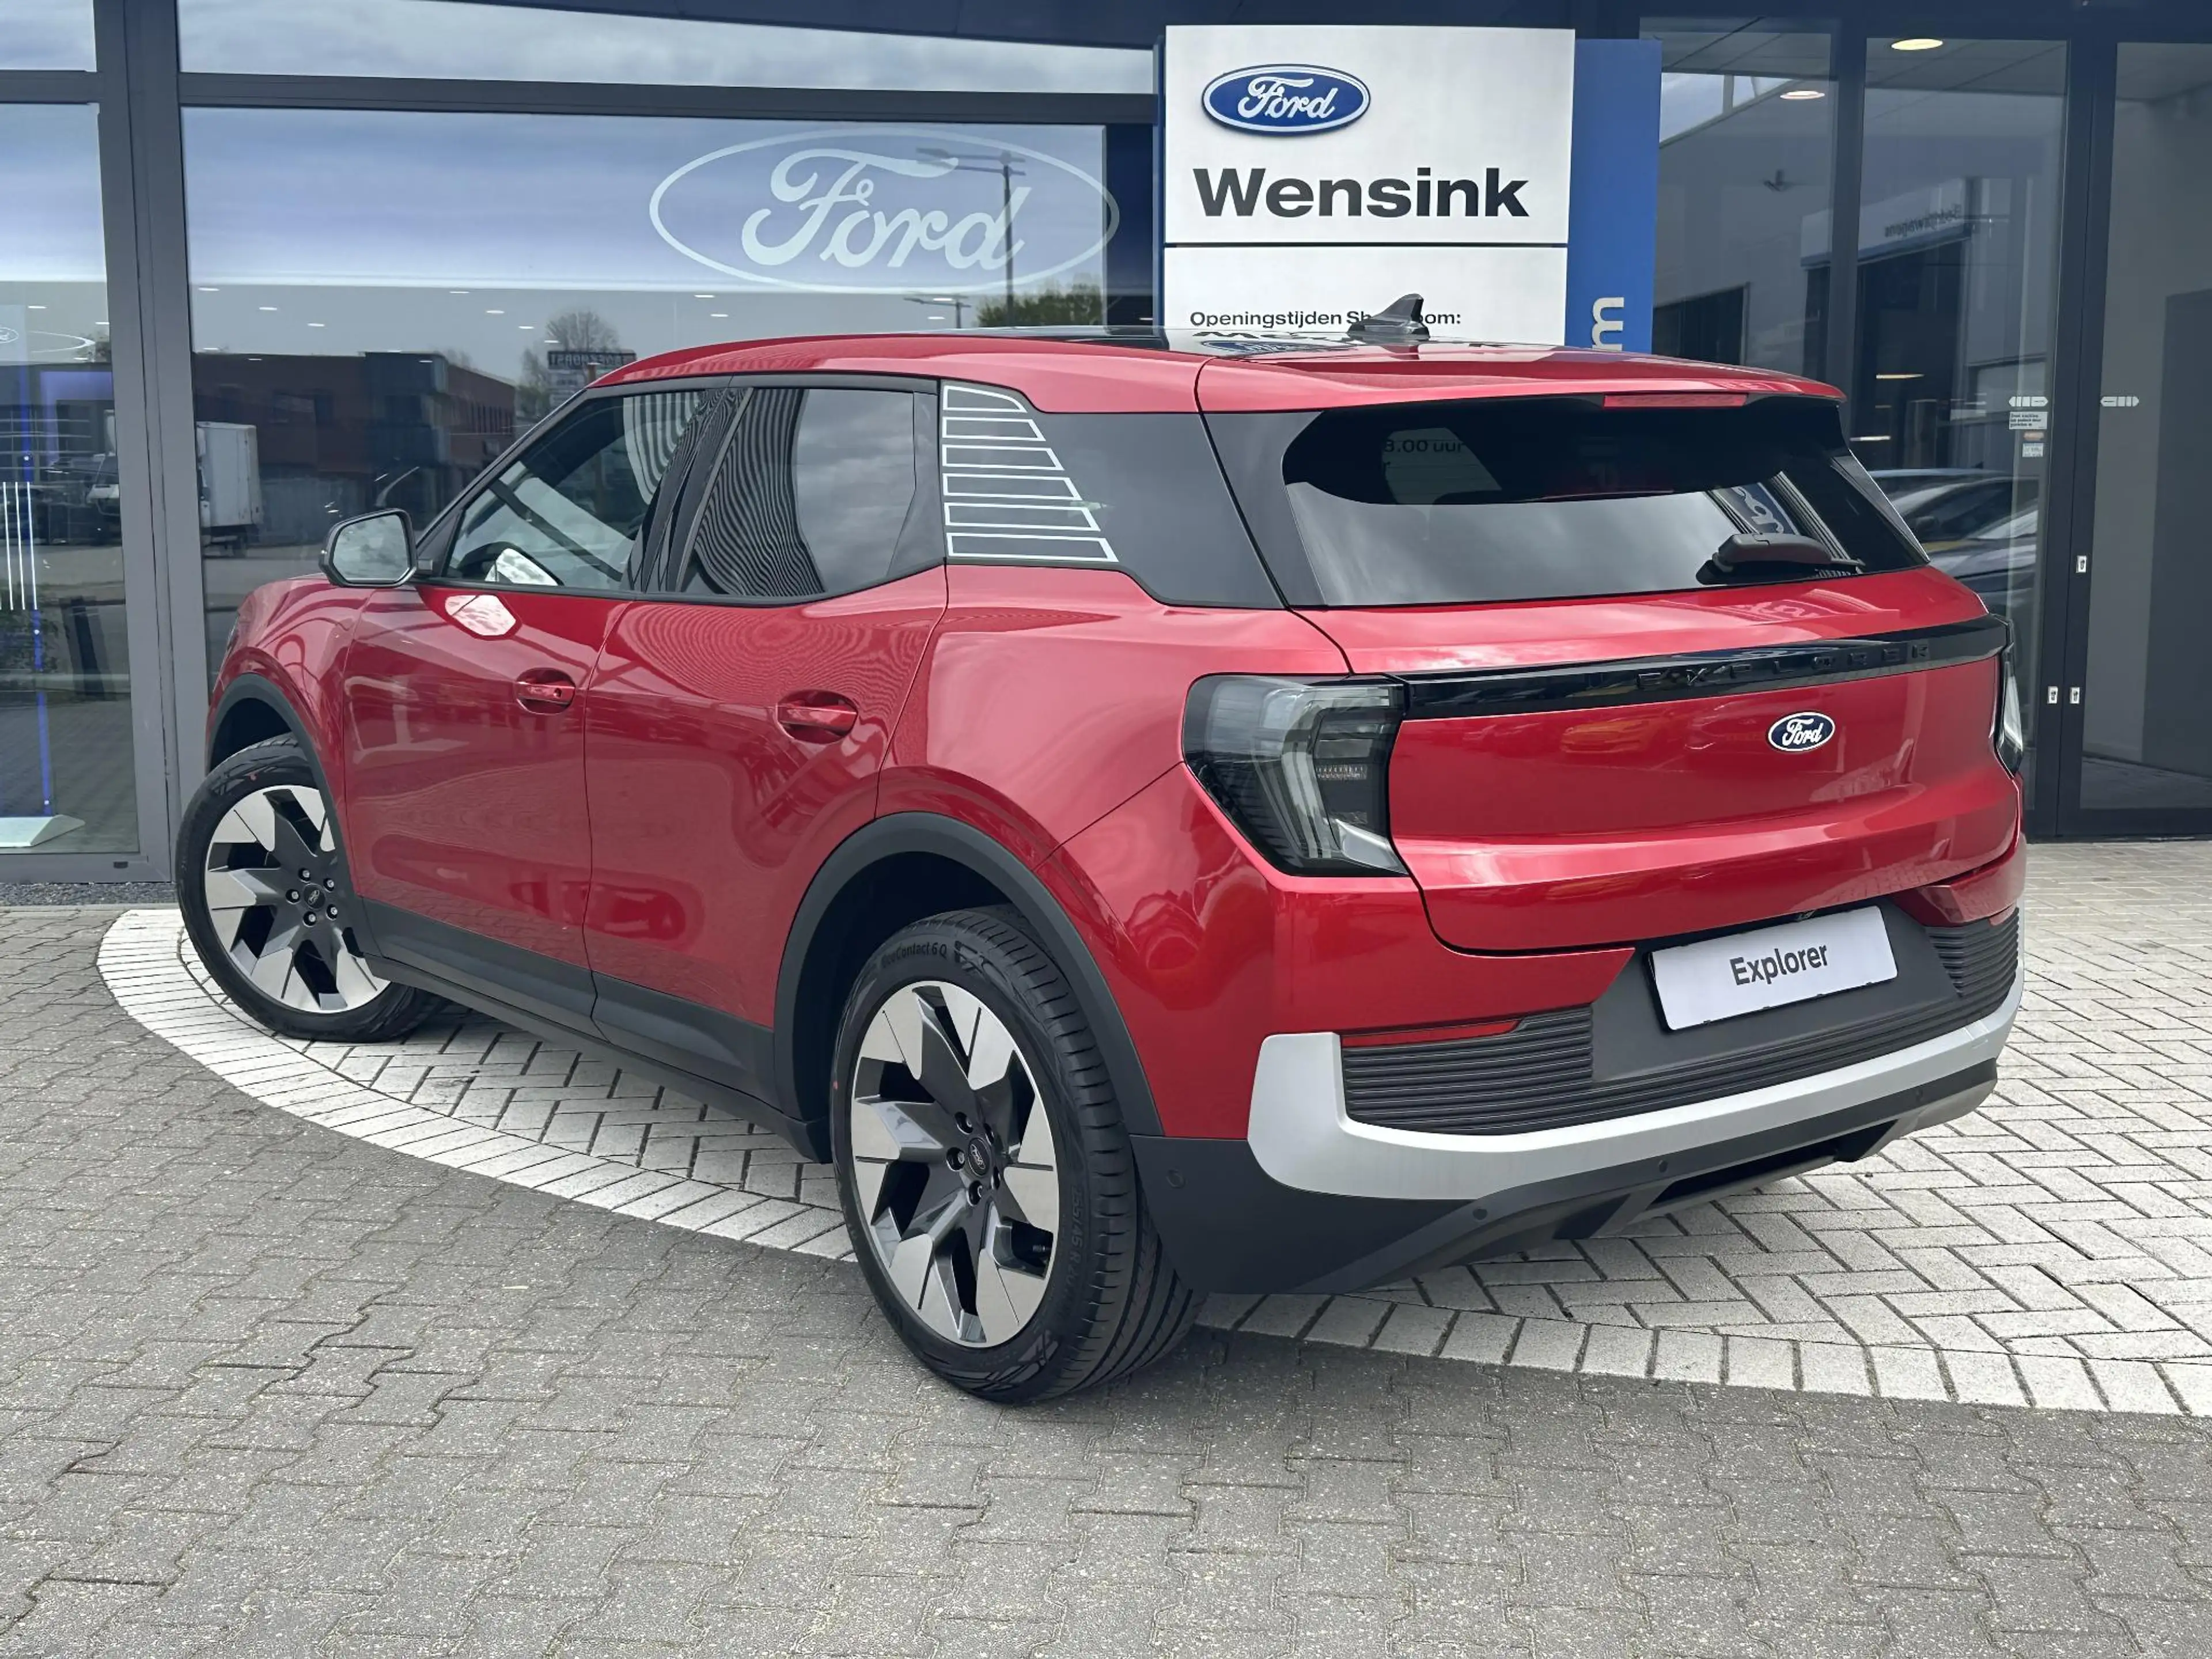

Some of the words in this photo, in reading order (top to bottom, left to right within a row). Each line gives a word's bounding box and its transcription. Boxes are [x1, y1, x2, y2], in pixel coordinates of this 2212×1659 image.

[1237, 76, 1338, 120] Ford
[741, 148, 1032, 270] Ford
[1192, 167, 1530, 218] Wensink
[1190, 310, 1342, 328] Openingstijden
[1635, 643, 1930, 690] EXPLORER
[1782, 718, 1823, 746] Ford
[1729, 945, 1828, 986] Explorer
